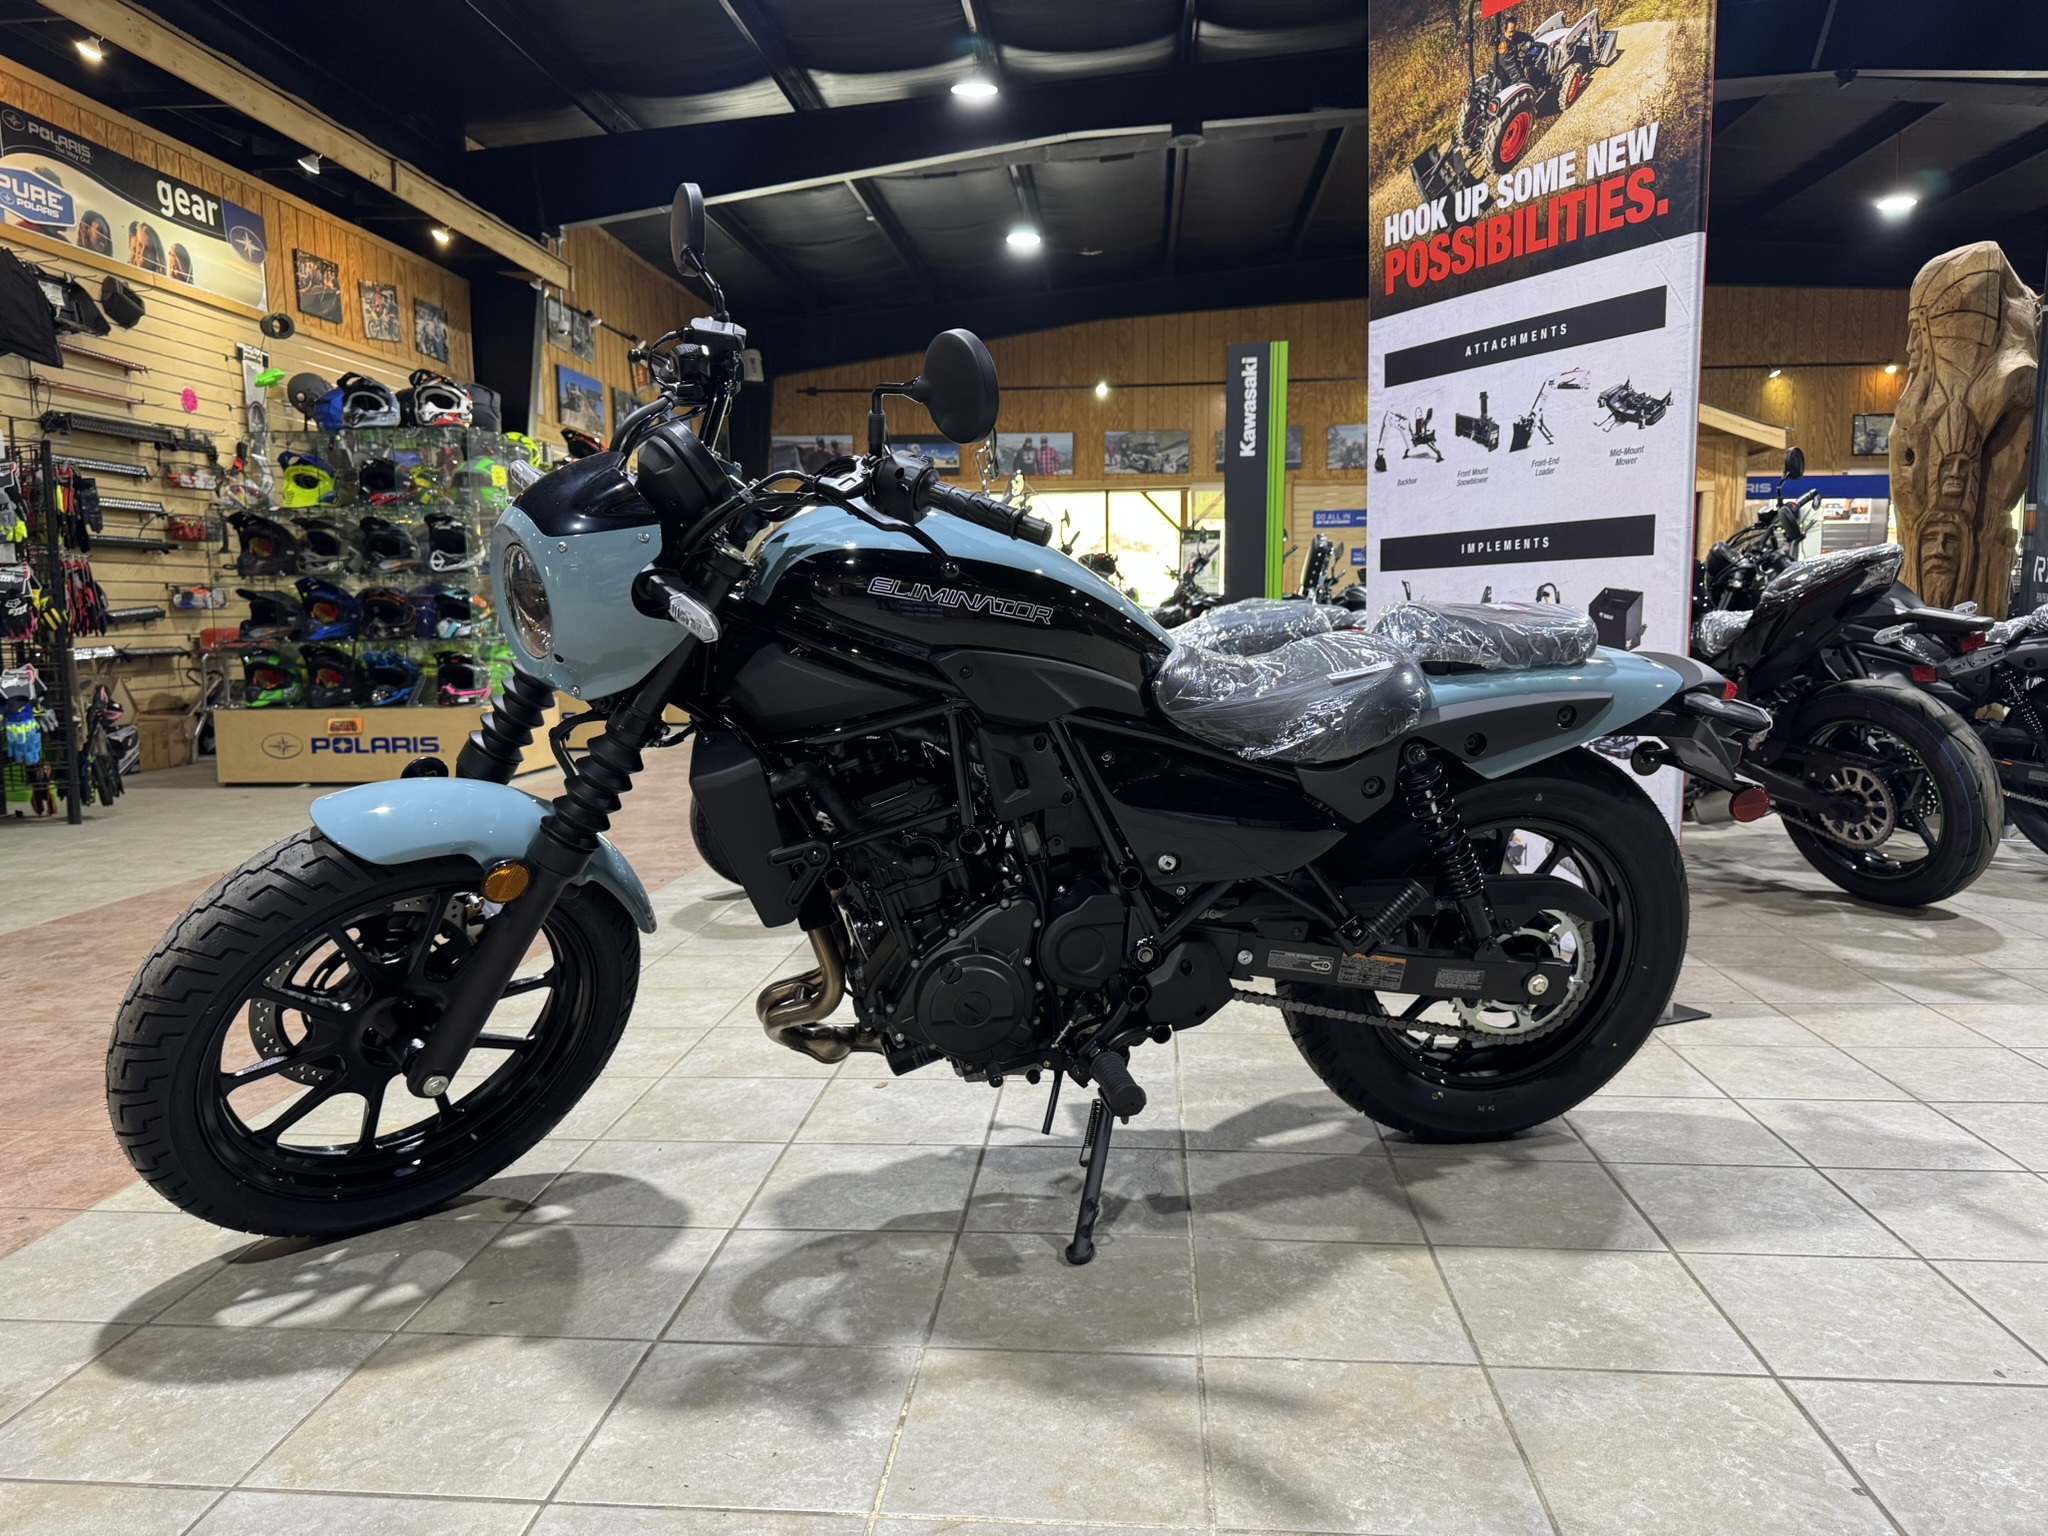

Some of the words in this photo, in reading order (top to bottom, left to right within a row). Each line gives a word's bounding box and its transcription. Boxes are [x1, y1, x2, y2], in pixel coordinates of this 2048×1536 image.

[28, 121, 92, 158] POLARIS
[0, 174, 64, 211] PURE
[1384, 196, 1448, 247] HOOK
[1454, 182, 1490, 224] UP
[1496, 150, 1577, 209] SOME
[1586, 121, 1660, 181] NEW
[16, 198, 60, 219] POLARIS
[156, 179, 219, 227] gear
[1385, 167, 1669, 295] POSSIBILITIES.
[1465, 323, 1568, 357] ATTACHMENTS
[1239, 356, 1258, 457] Kawasaki
[1609, 445, 1645, 457] Mid-Mount
[1615, 457, 1638, 466] Mower
[1457, 469, 1472, 478] Front
[1472, 467, 1489, 476] Mount
[1531, 457, 1560, 468] Front-End
[1535, 467, 1556, 476] Loader
[1457, 477, 1489, 487] Snowblower
[1461, 536, 1550, 555] IMPLEMENTS
[867, 576, 1054, 625] ELIMINATOR
[311, 736, 440, 754] POLARIS
